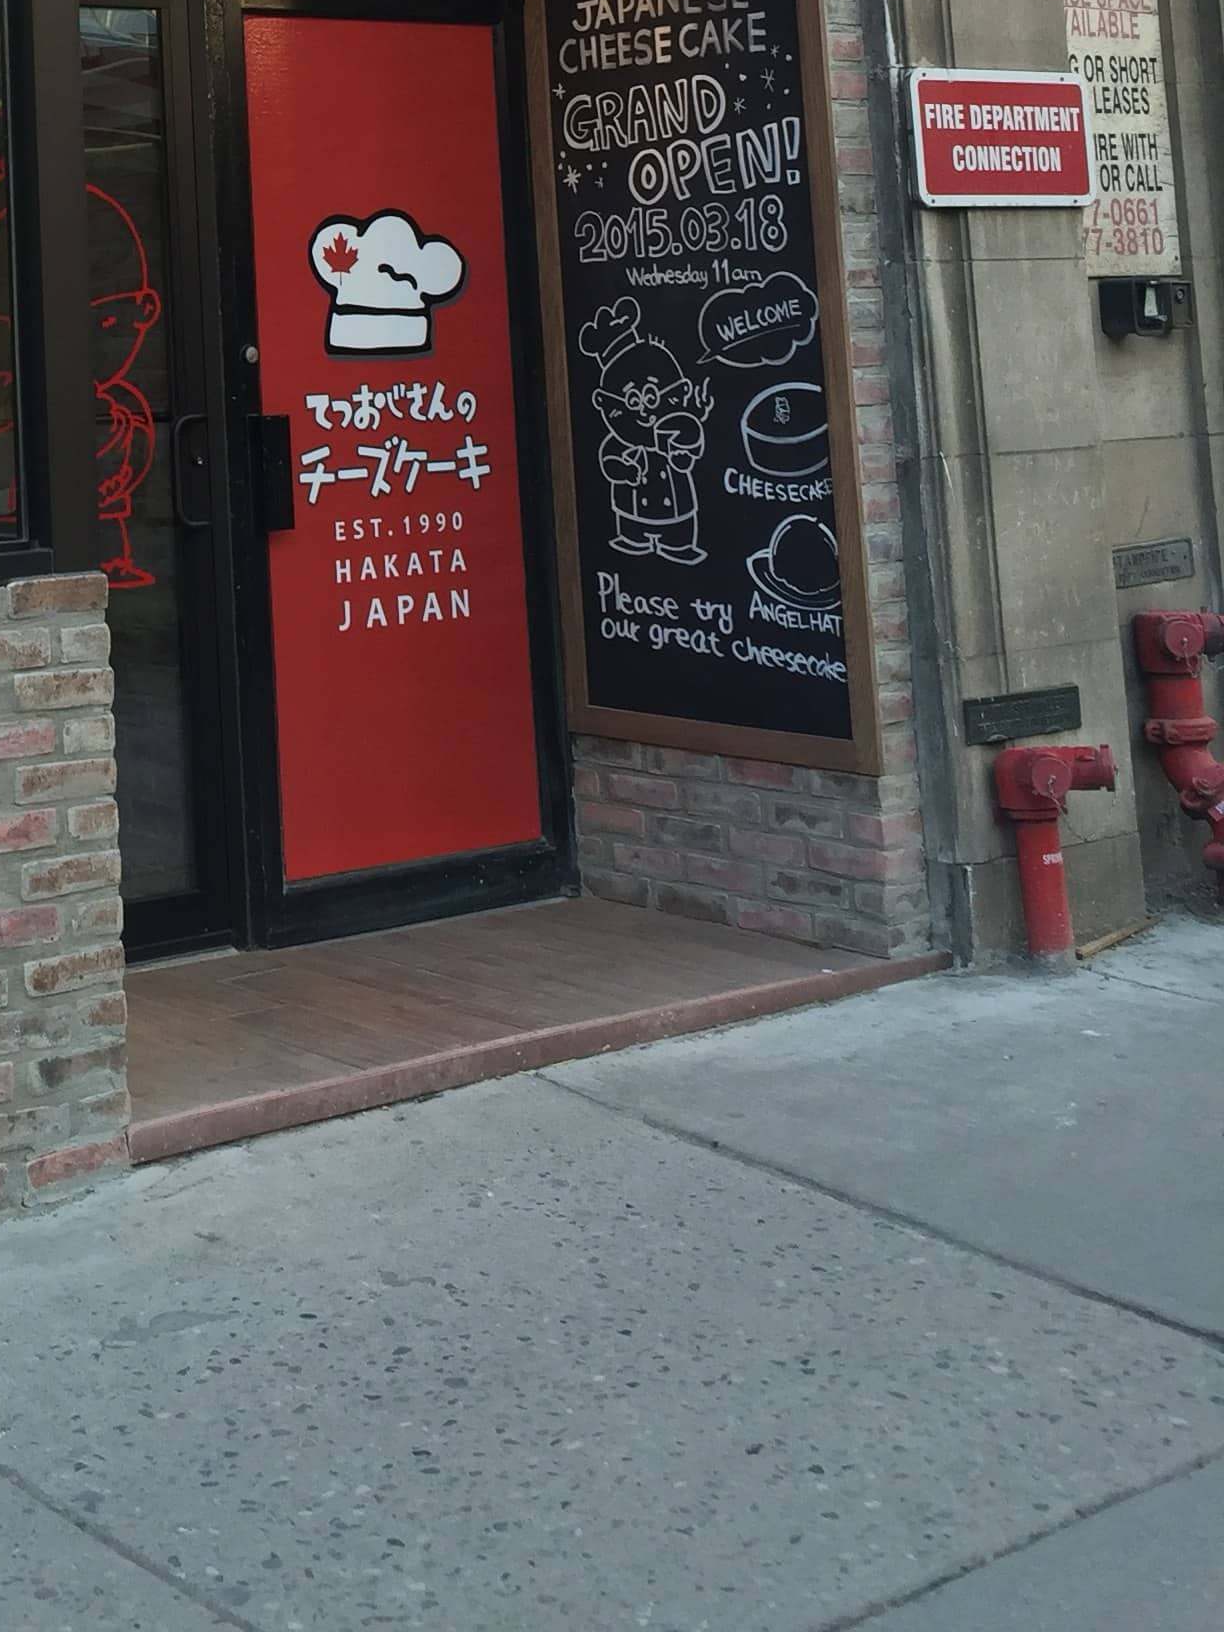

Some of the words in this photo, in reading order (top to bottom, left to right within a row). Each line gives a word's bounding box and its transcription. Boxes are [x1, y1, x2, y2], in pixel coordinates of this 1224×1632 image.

[558, 25, 673, 74] CHEESE
[678, 11, 767, 59] CAKE
[1083, 55, 1105, 83] OR
[1109, 55, 1157, 84] SHORT
[562, 74, 727, 152] GRAND
[924, 103, 966, 130] FIRE
[969, 104, 1080, 133] DEPARTMENT
[1093, 87, 1150, 115] LEASES
[628, 116, 801, 206] OPEN!
[952, 144, 1062, 173] CONNECTION
[1121, 133, 1159, 161] WITH
[1099, 164, 1122, 192] OR
[1125, 164, 1163, 192] CALL
[574, 194, 789, 263] 2015.03.18
[625, 263, 709, 289] Wednesday
[715, 298, 803, 343] WELCOME
[305, 381, 477, 431] てつおじさんの
[298, 435, 492, 504] チーズケーキ
[334, 548, 468, 585] HAKATA
[337, 588, 471, 633] JAPAN
[597, 571, 679, 620] Please
[689, 598, 733, 635] try
[648, 623, 725, 658] great
